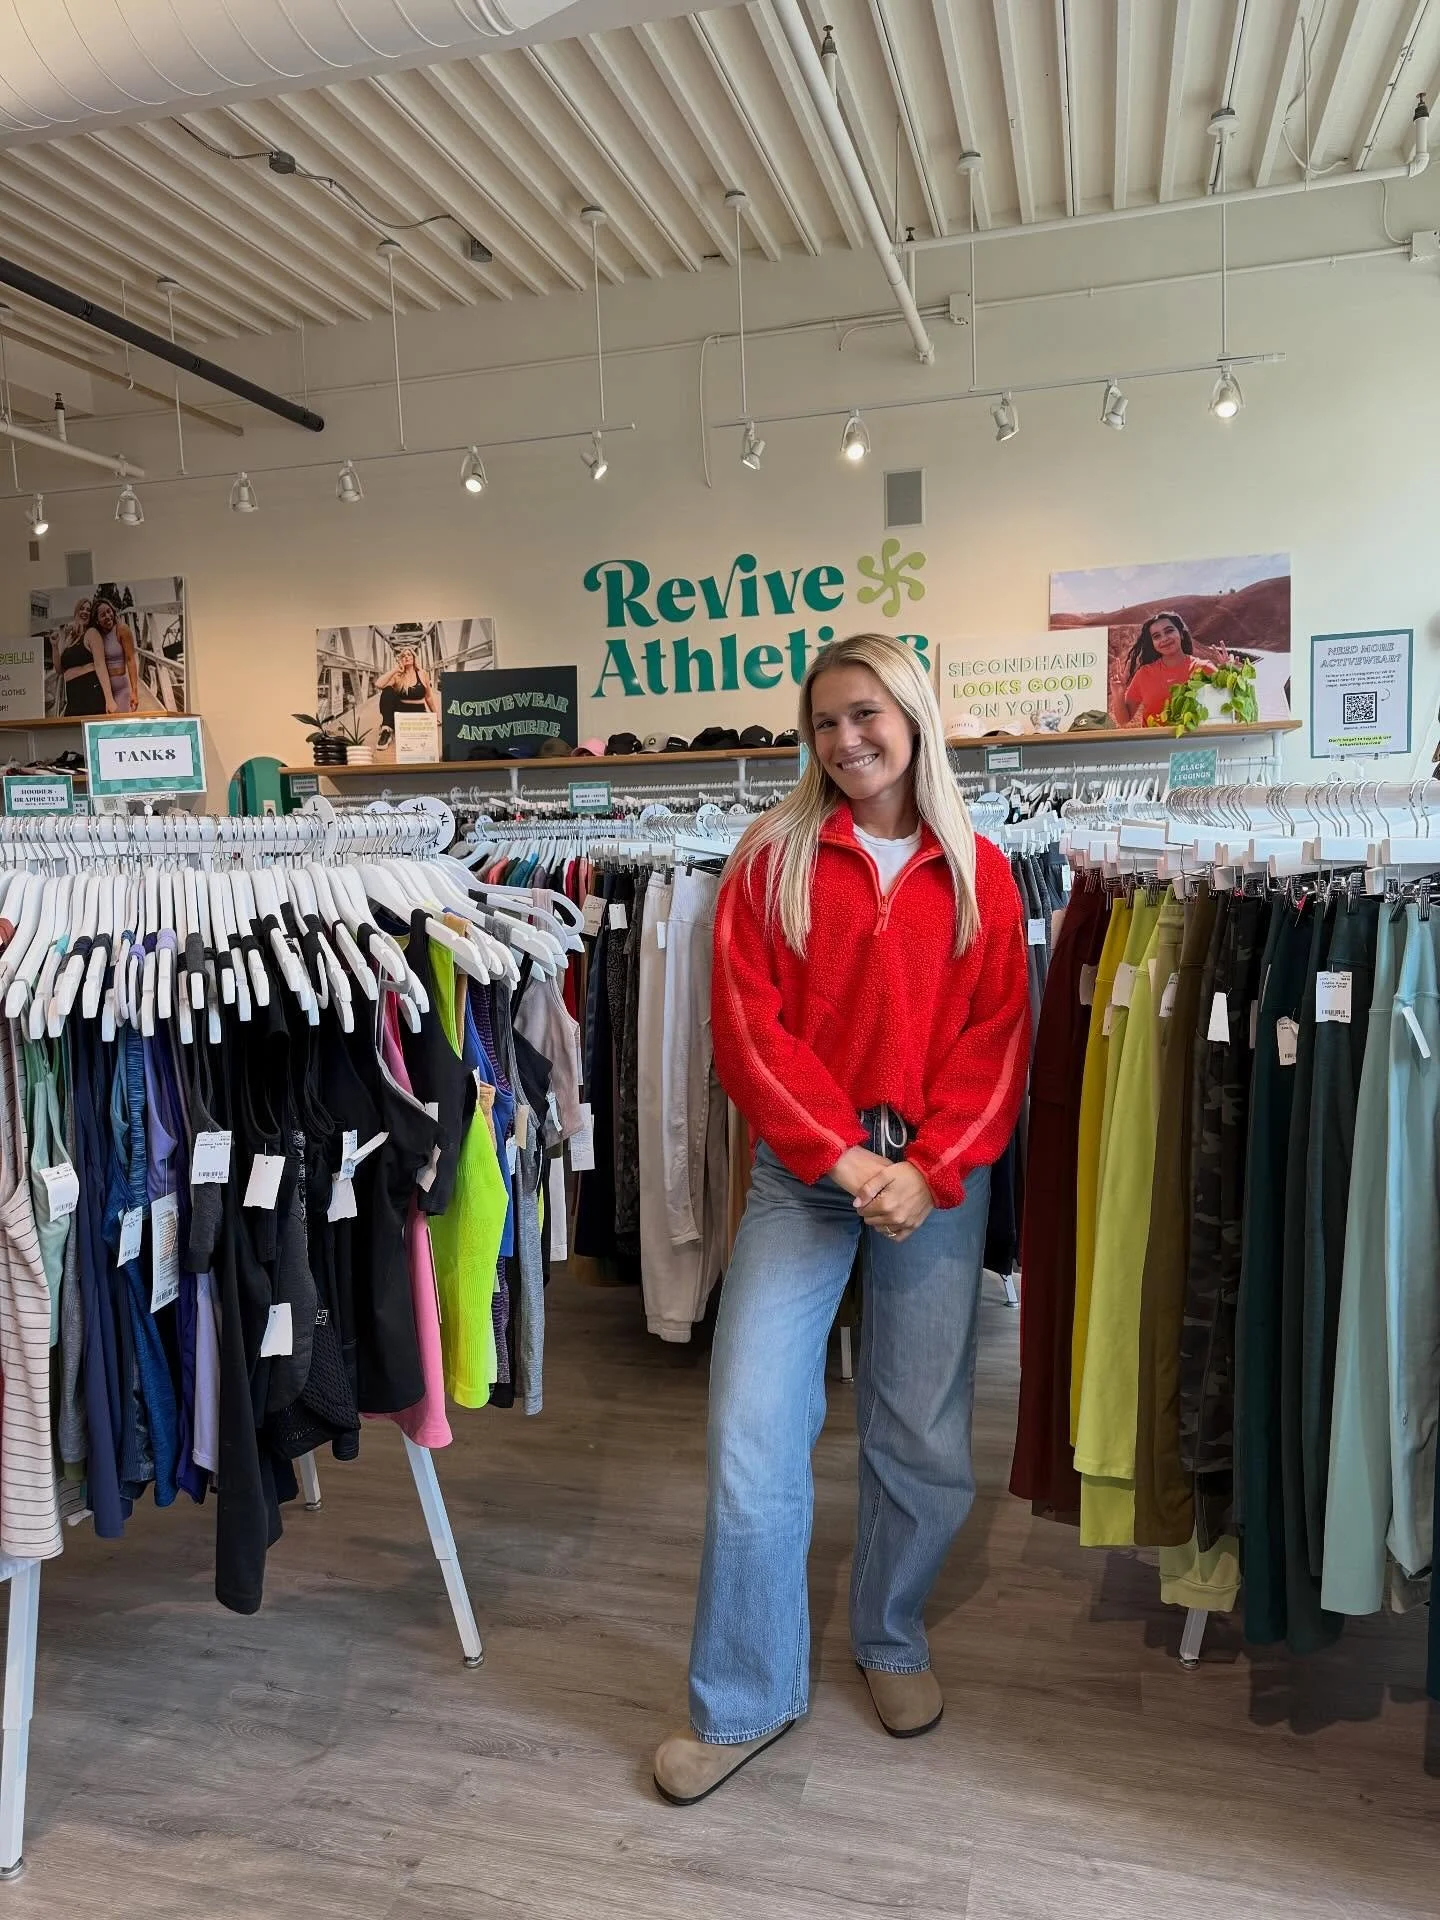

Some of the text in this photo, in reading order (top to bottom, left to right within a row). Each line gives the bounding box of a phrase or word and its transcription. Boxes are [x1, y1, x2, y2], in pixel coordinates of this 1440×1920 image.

[583, 553, 844, 628] Revive
[1328, 642, 1395, 656] NEED MORE
[949, 652, 1098, 678] SECONDHAND
[1, 688, 26, 697] CLOTHES
[953, 674, 1093, 699] LOOKS GOOD
[447, 692, 569, 717] ACTIVEWEAR
[969, 702, 999, 718] ON
[457, 720, 561, 741] ANYWHERE
[115, 749, 176, 763] TANKS
[1180, 762, 1206, 772] BLACK
[412, 802, 427, 813] XL
